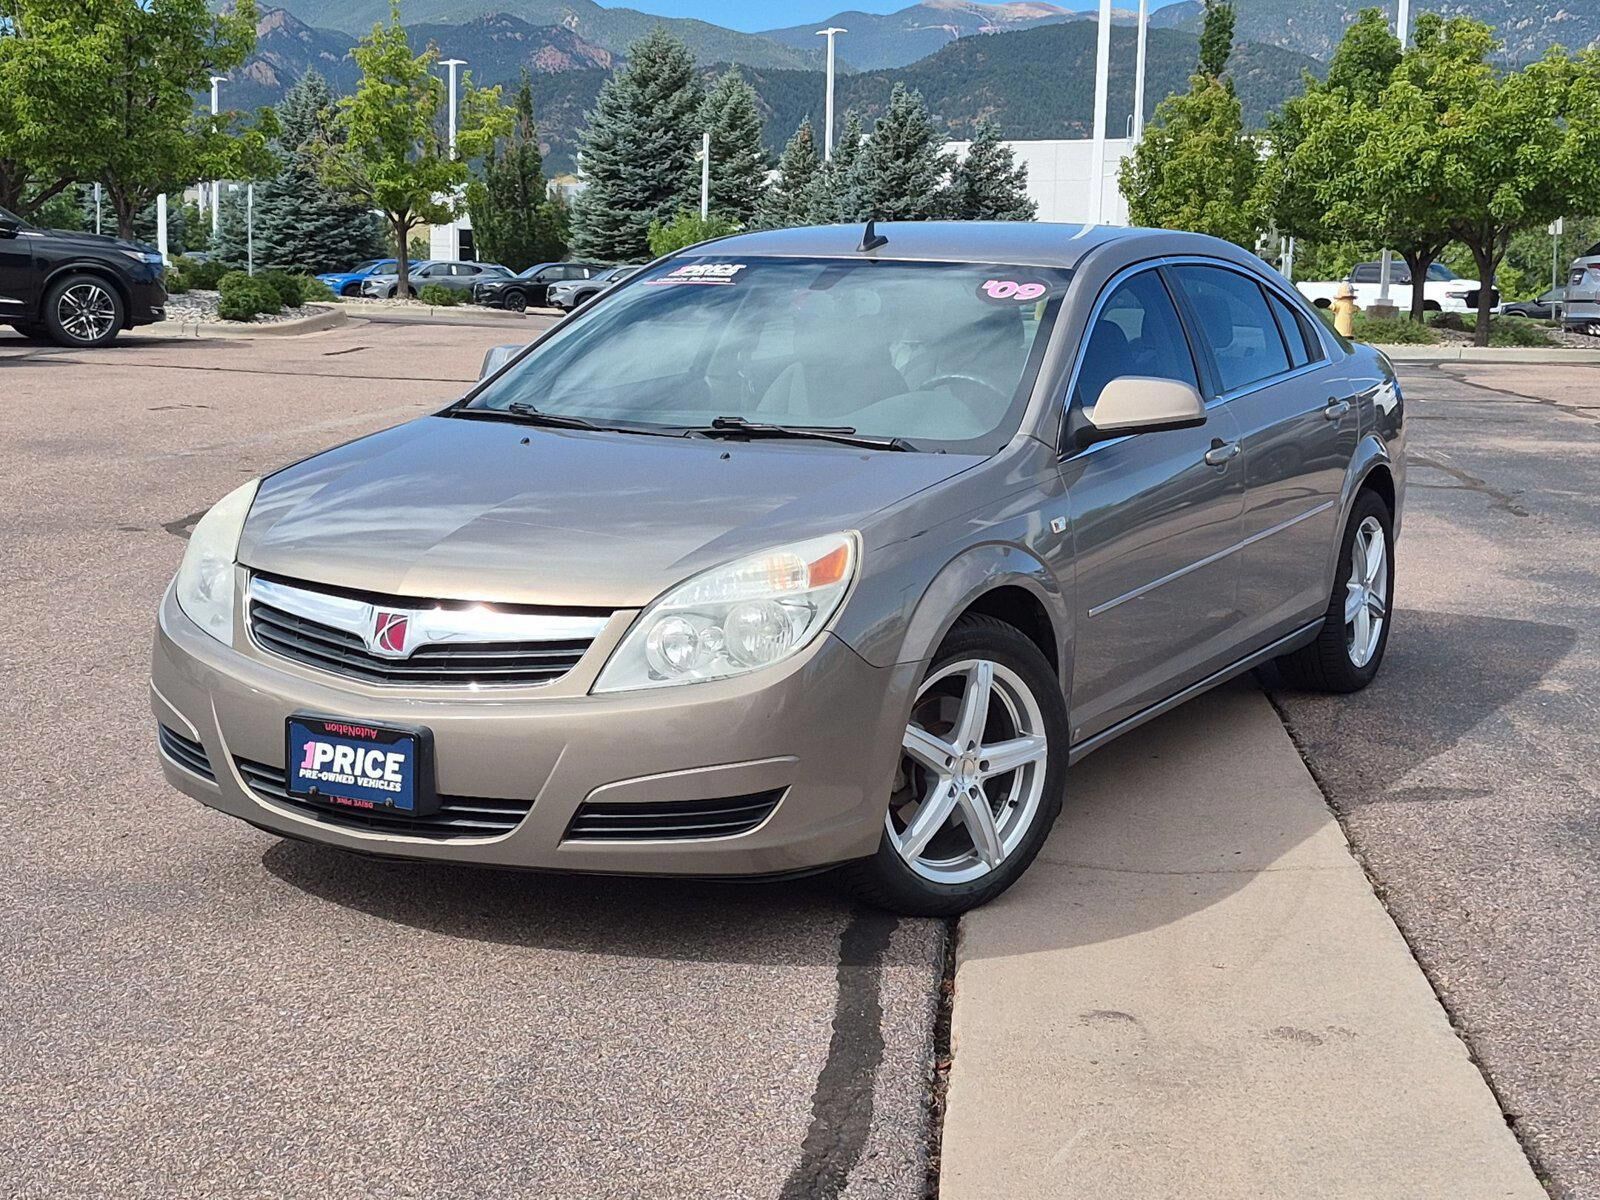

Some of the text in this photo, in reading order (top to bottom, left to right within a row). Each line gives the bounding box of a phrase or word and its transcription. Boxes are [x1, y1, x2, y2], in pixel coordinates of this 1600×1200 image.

[325, 723, 377, 739] AutoNation
[299, 769, 402, 791] PRE-OWNED VEHICLES
